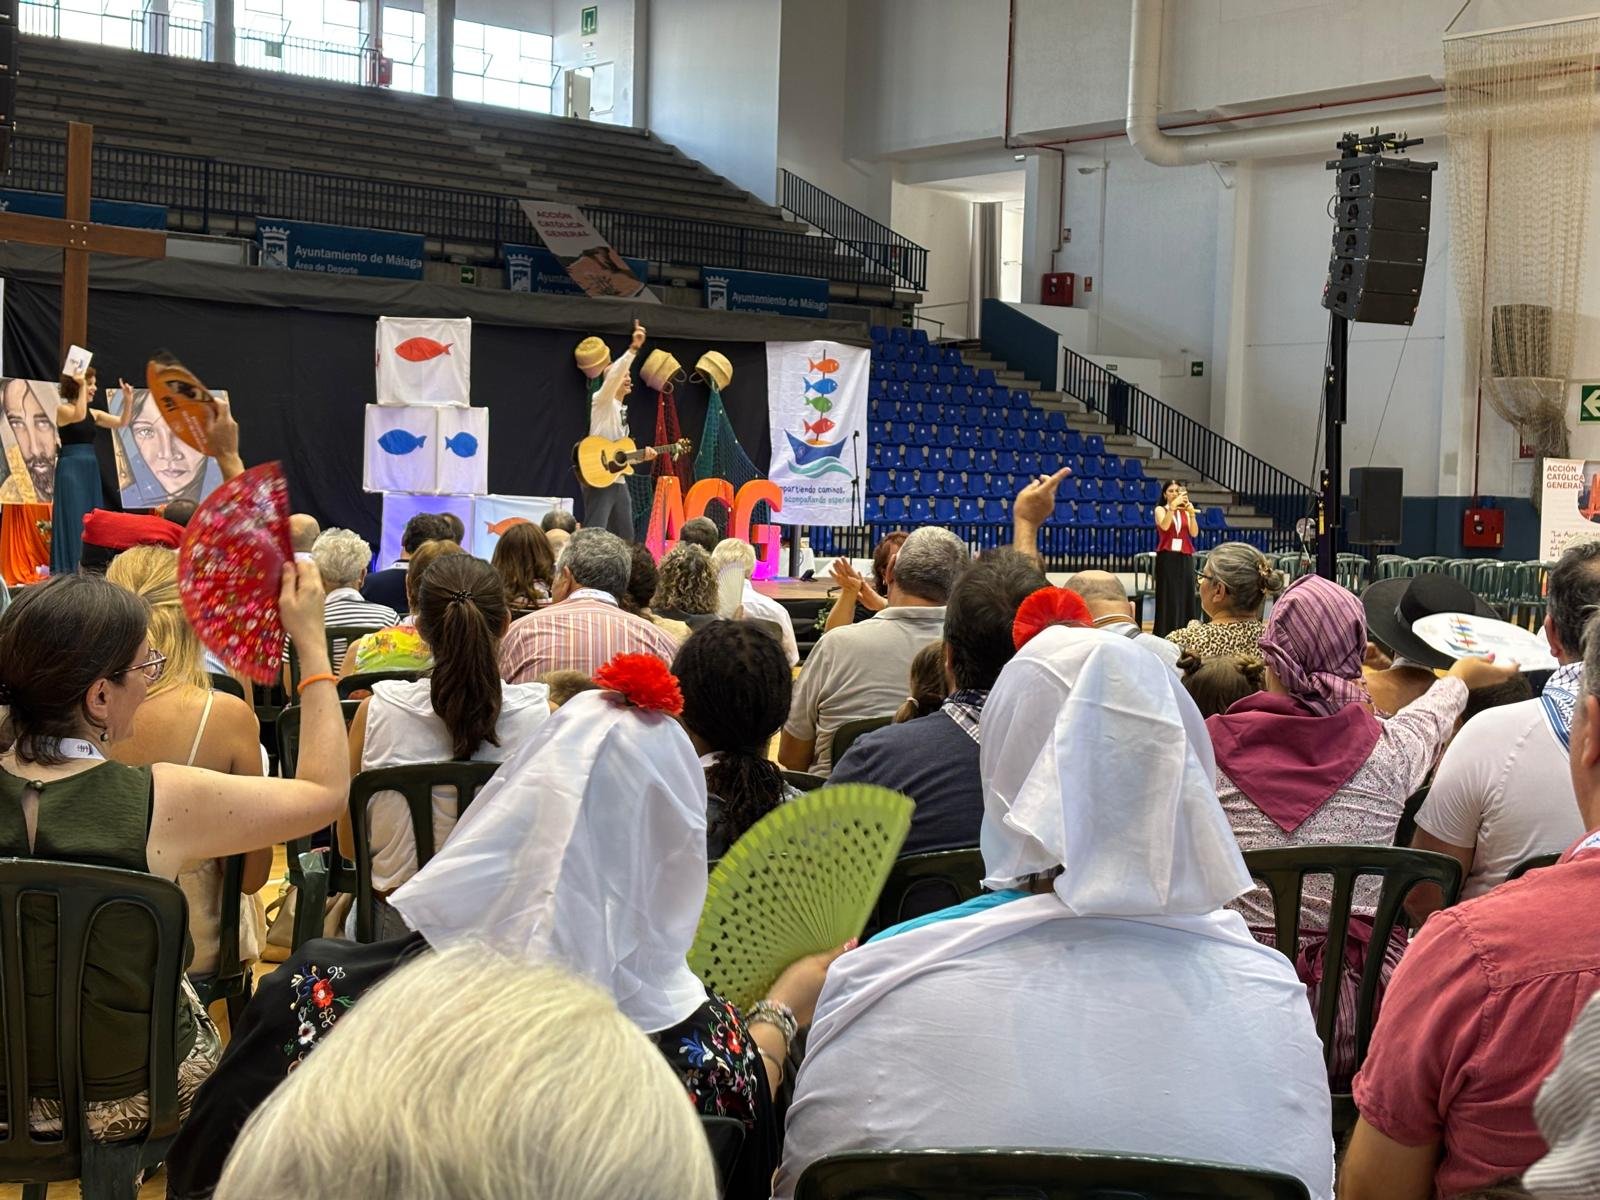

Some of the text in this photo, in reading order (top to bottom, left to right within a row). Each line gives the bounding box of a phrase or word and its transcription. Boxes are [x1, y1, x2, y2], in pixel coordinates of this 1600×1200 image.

[537, 211, 572, 219] ACCIÓN
[538, 220, 585, 228] CATÓLICA
[294, 246, 423, 270] Ayuntamiento de Málaga
[315, 263, 327, 272] de
[327, 264, 359, 275] Deporte
[537, 272, 577, 284] Ayunta
[732, 292, 787, 306] Ayuntamiento
[788, 297, 799, 307] de
[779, 484, 816, 494] partiendo
